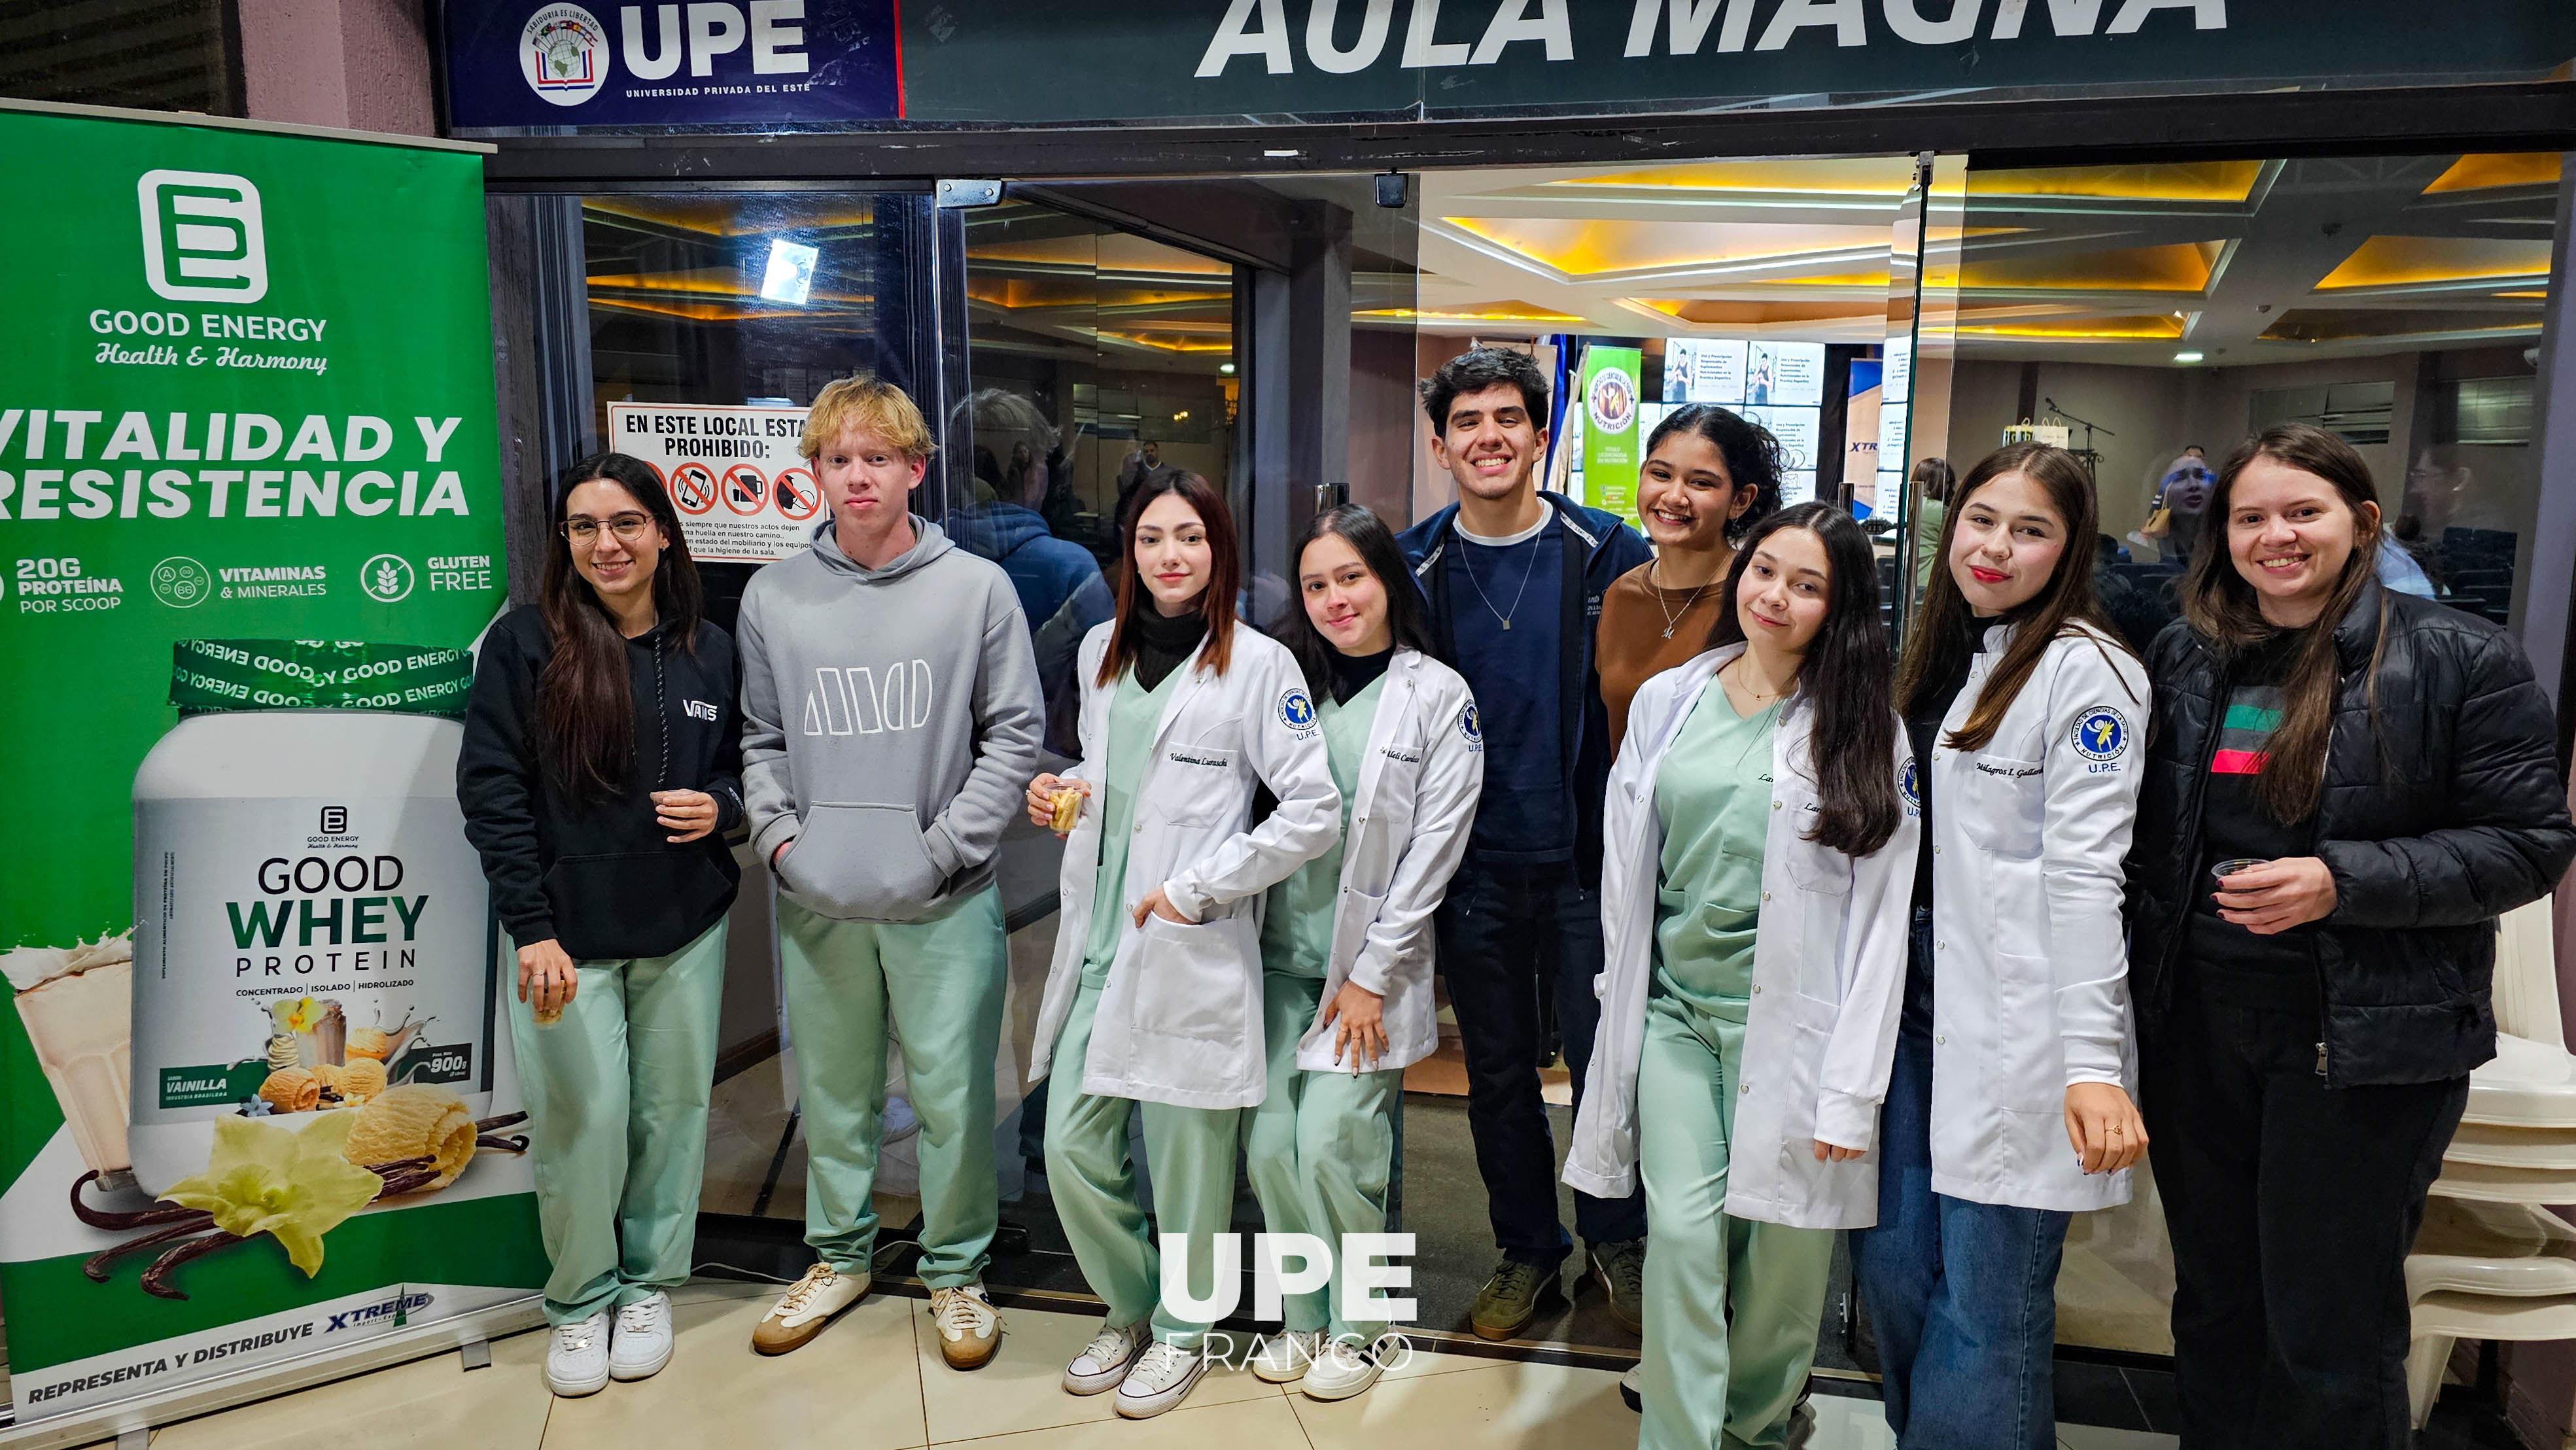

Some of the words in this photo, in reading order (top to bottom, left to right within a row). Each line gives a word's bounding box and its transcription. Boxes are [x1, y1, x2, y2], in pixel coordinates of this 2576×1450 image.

[527, 10, 559, 35] SABIDURIA
[569, 10, 599, 31] LIBERTAD
[621, 1, 810, 80] UPE
[1194, 0, 1575, 77] AULA
[626, 88, 699, 98] UNIVERSIDAD
[705, 86, 751, 95] PRIVADA
[757, 84, 779, 94] DEL
[783, 83, 810, 93] ESTE
[90, 309, 189, 337] GOOD
[202, 314, 327, 342] ENERGY
[95, 343, 178, 366] Health
[186, 348, 208, 365] &
[216, 346, 327, 376] Harmony
[626, 415, 648, 433] EN
[655, 415, 696, 434] ESTE
[703, 417, 759, 436] LOCAL
[414, 416, 462, 462] Y
[665, 438, 770, 458] PROHIBIDO:
[1849, 442, 1877, 453] XTR
[16, 558, 80, 579] 20G
[428, 555, 490, 570] GLUTEN
[219, 566, 326, 582] VITAMINAS
[430, 570, 492, 591] FREE
[18, 576, 124, 596] PROTEÍNA
[220, 587, 232, 598] &
[237, 583, 326, 598] MINERALES
[20, 600, 57, 613] POR
[62, 596, 121, 612] SCOOP
[343, 659, 402, 681] GOOD
[406, 648, 460, 670] ENERGY
[404, 679, 459, 702] ENERGY
[683, 699, 718, 721] VANS
[2081, 745, 2124, 759] NUTRICIÓN
[1976, 763, 2008, 776] Milagros
[2089, 762, 2121, 774] U.P.E.
[258, 855, 404, 895] GOOD
[226, 895, 430, 949] WHEY
[236, 948, 416, 978] PROTEIN
[236, 986, 304, 997] CONCENTRADO
[311, 983, 351, 993] ISOLADO
[358, 979, 414, 990] HIDROLIZADO
[430, 1056, 467, 1073] 900g
[167, 1078, 227, 1094] VAINILLA
[323, 1292, 428, 1334] XTREME
[27, 1357, 167, 1405] REPRESENTA
[176, 1353, 190, 1369] Y
[193, 1322, 314, 1364] DISTRIBUYE
